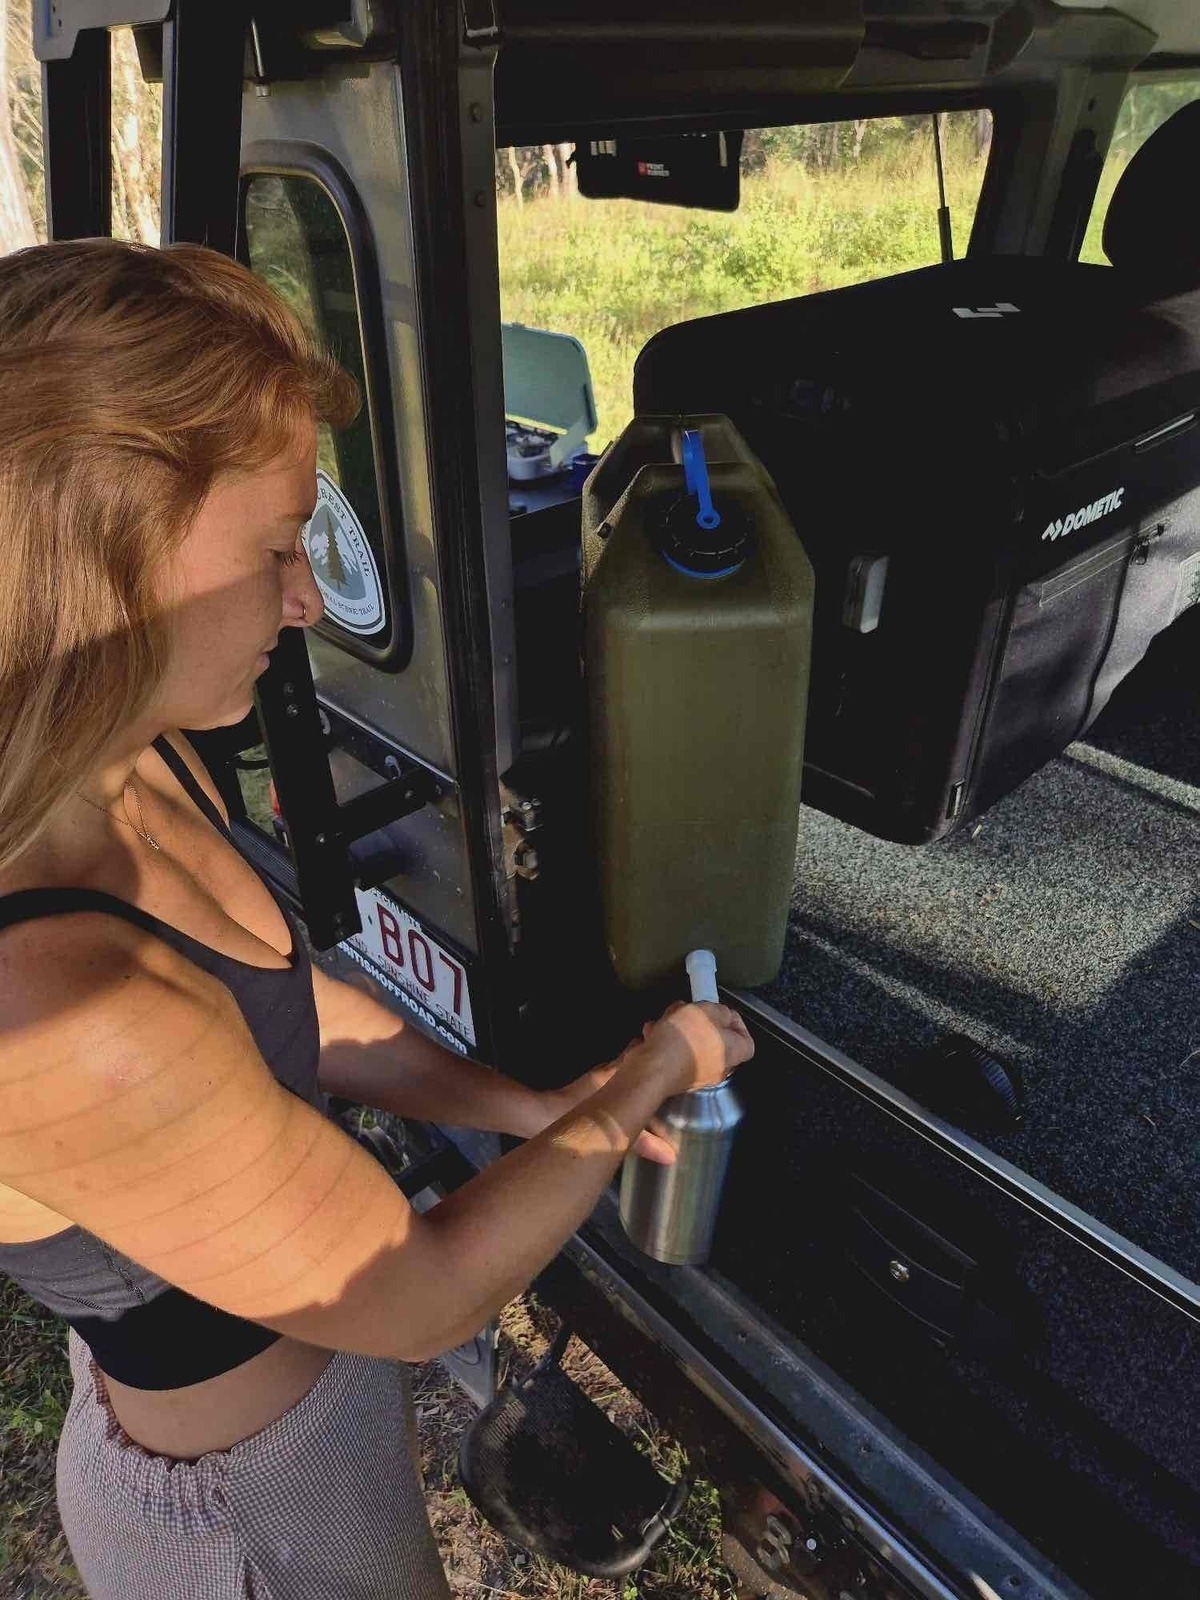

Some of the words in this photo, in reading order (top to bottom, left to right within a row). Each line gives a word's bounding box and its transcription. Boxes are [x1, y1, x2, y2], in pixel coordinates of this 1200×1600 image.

[1061, 487, 1125, 537] DOMETIC
[348, 526, 371, 577] TRAIL
[378, 953, 430, 1006] SUNSHINE
[436, 1003, 474, 1037] STATE
